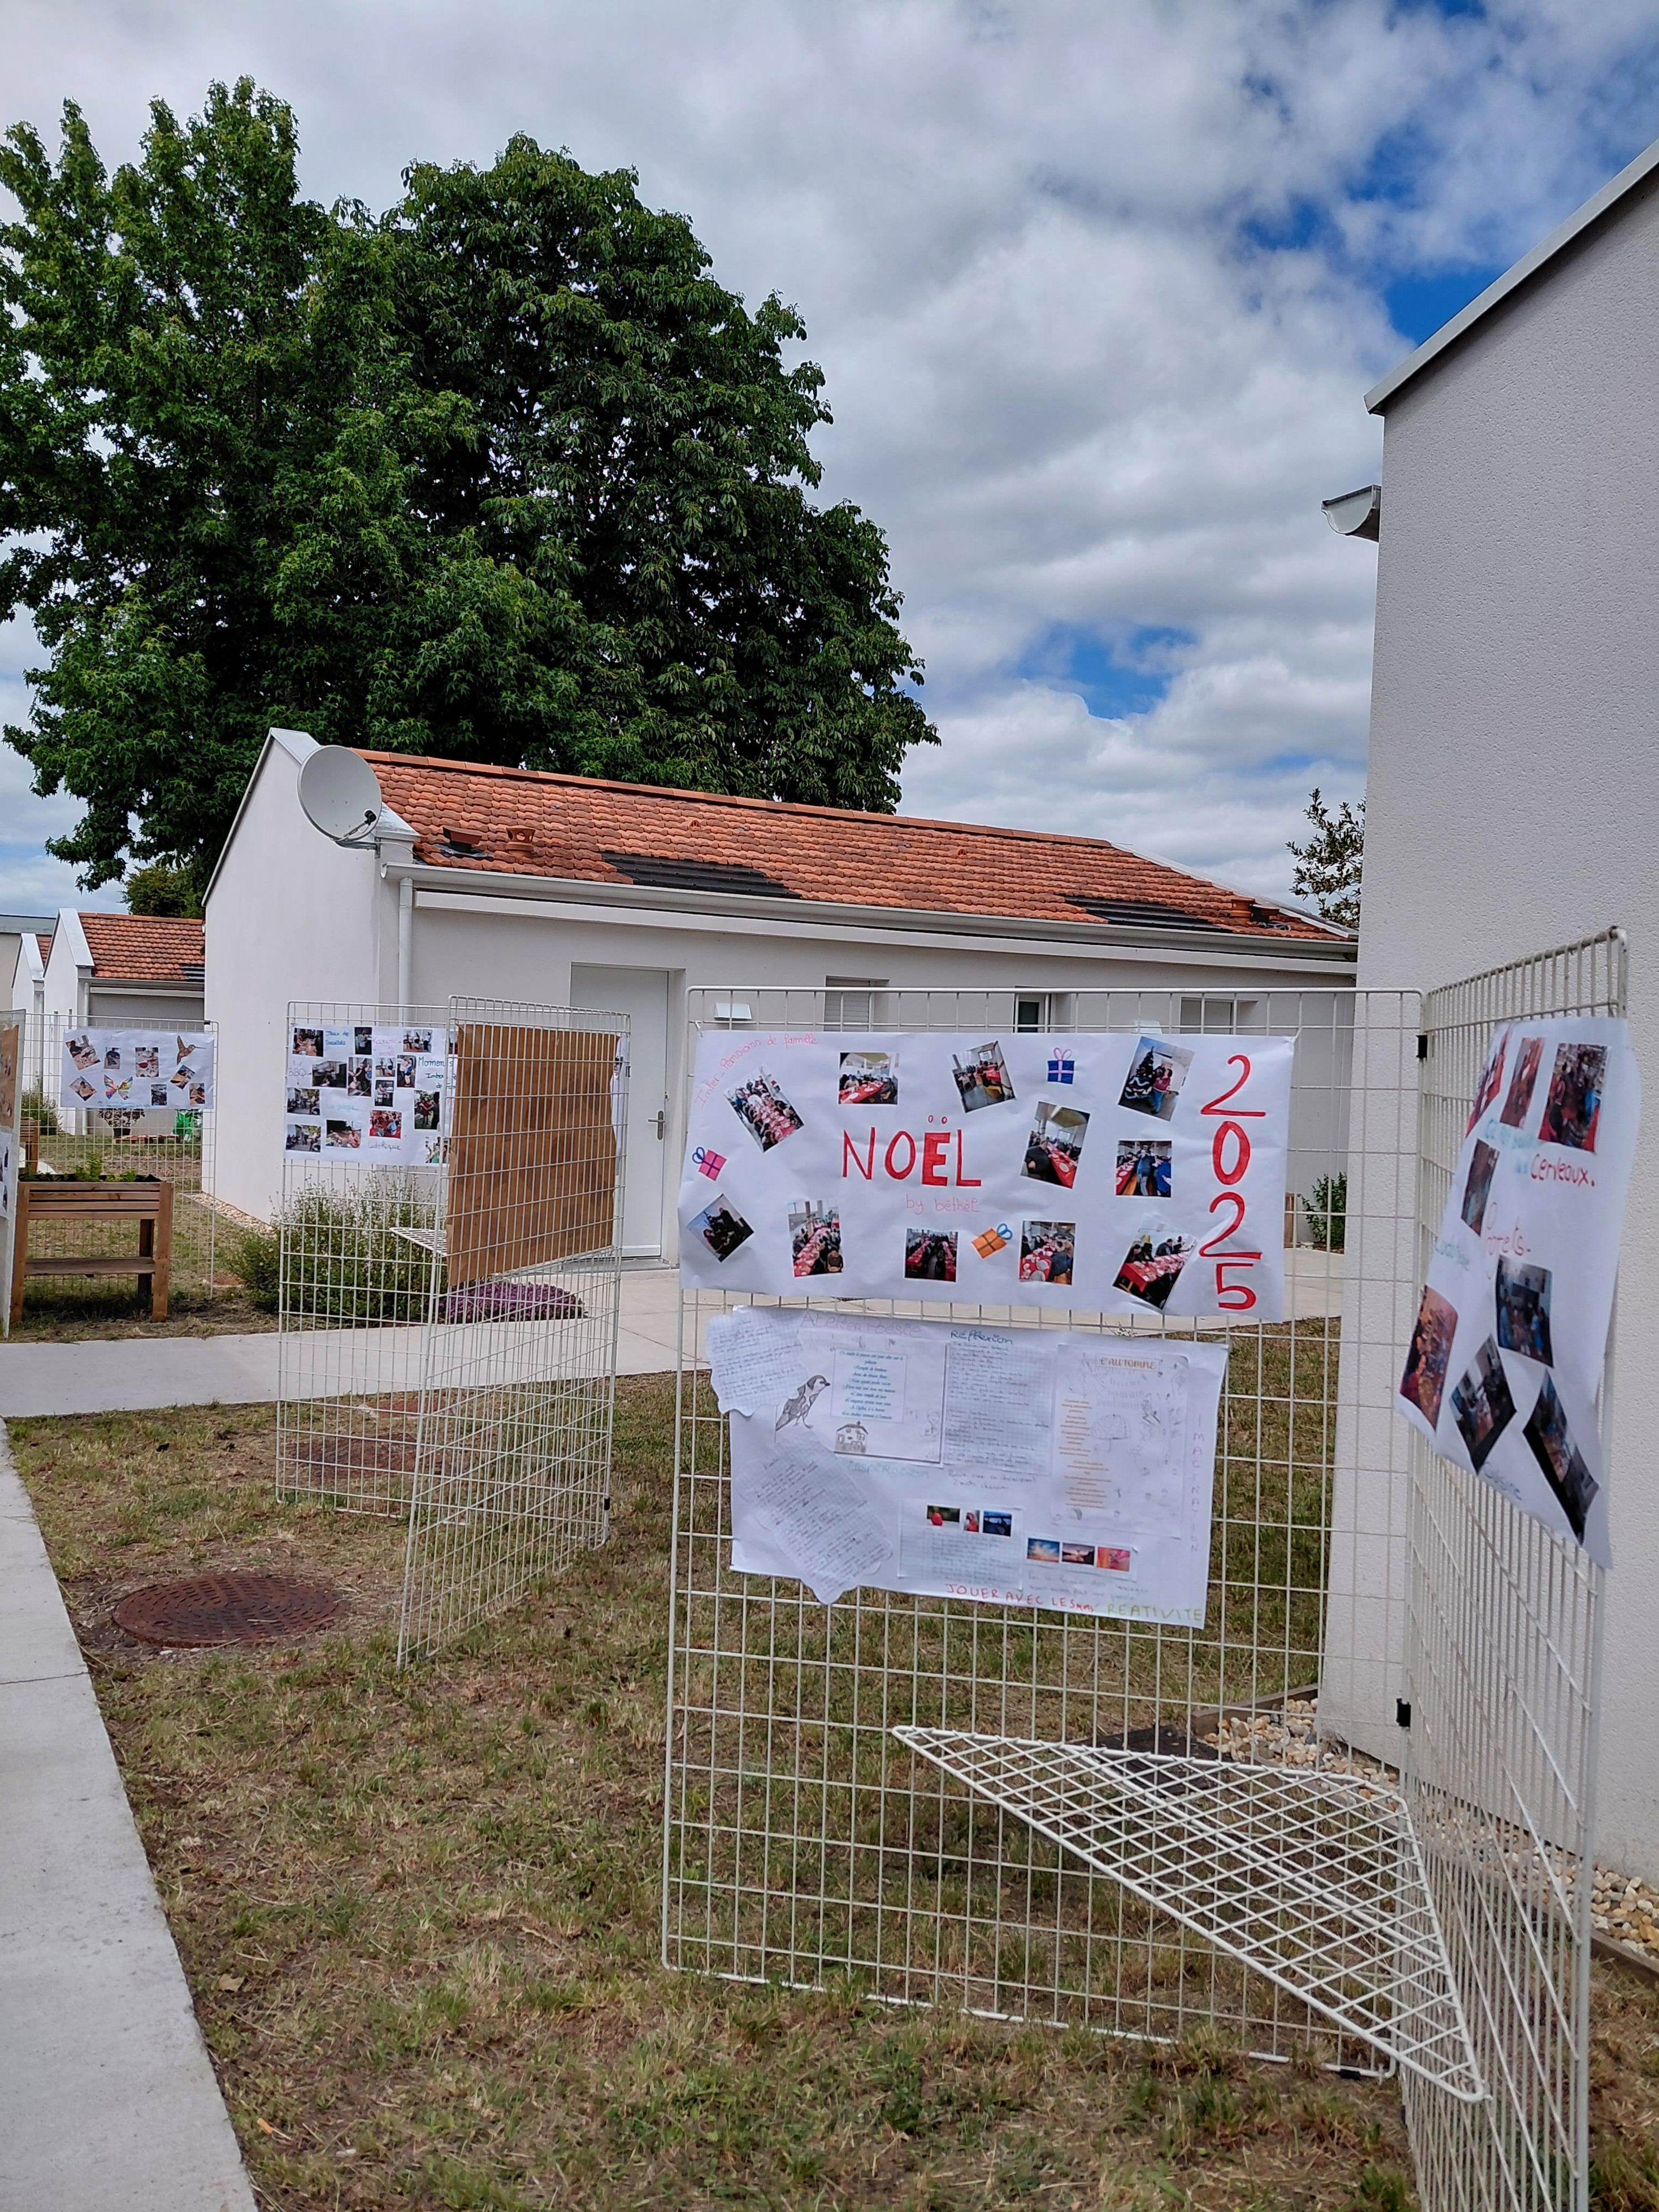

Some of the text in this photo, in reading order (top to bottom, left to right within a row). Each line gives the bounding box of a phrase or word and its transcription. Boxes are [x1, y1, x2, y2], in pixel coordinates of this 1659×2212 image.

[767, 1036, 777, 1045] de
[418, 1056, 454, 1067] Momens
[842, 1114, 982, 1187] NOËL
[906, 1193, 924, 1215] by
[945, 1583, 1000, 1599] JOUER
[1005, 1591, 1044, 1605] AVEC
[1094, 1602, 1203, 1621] REATIVITE
